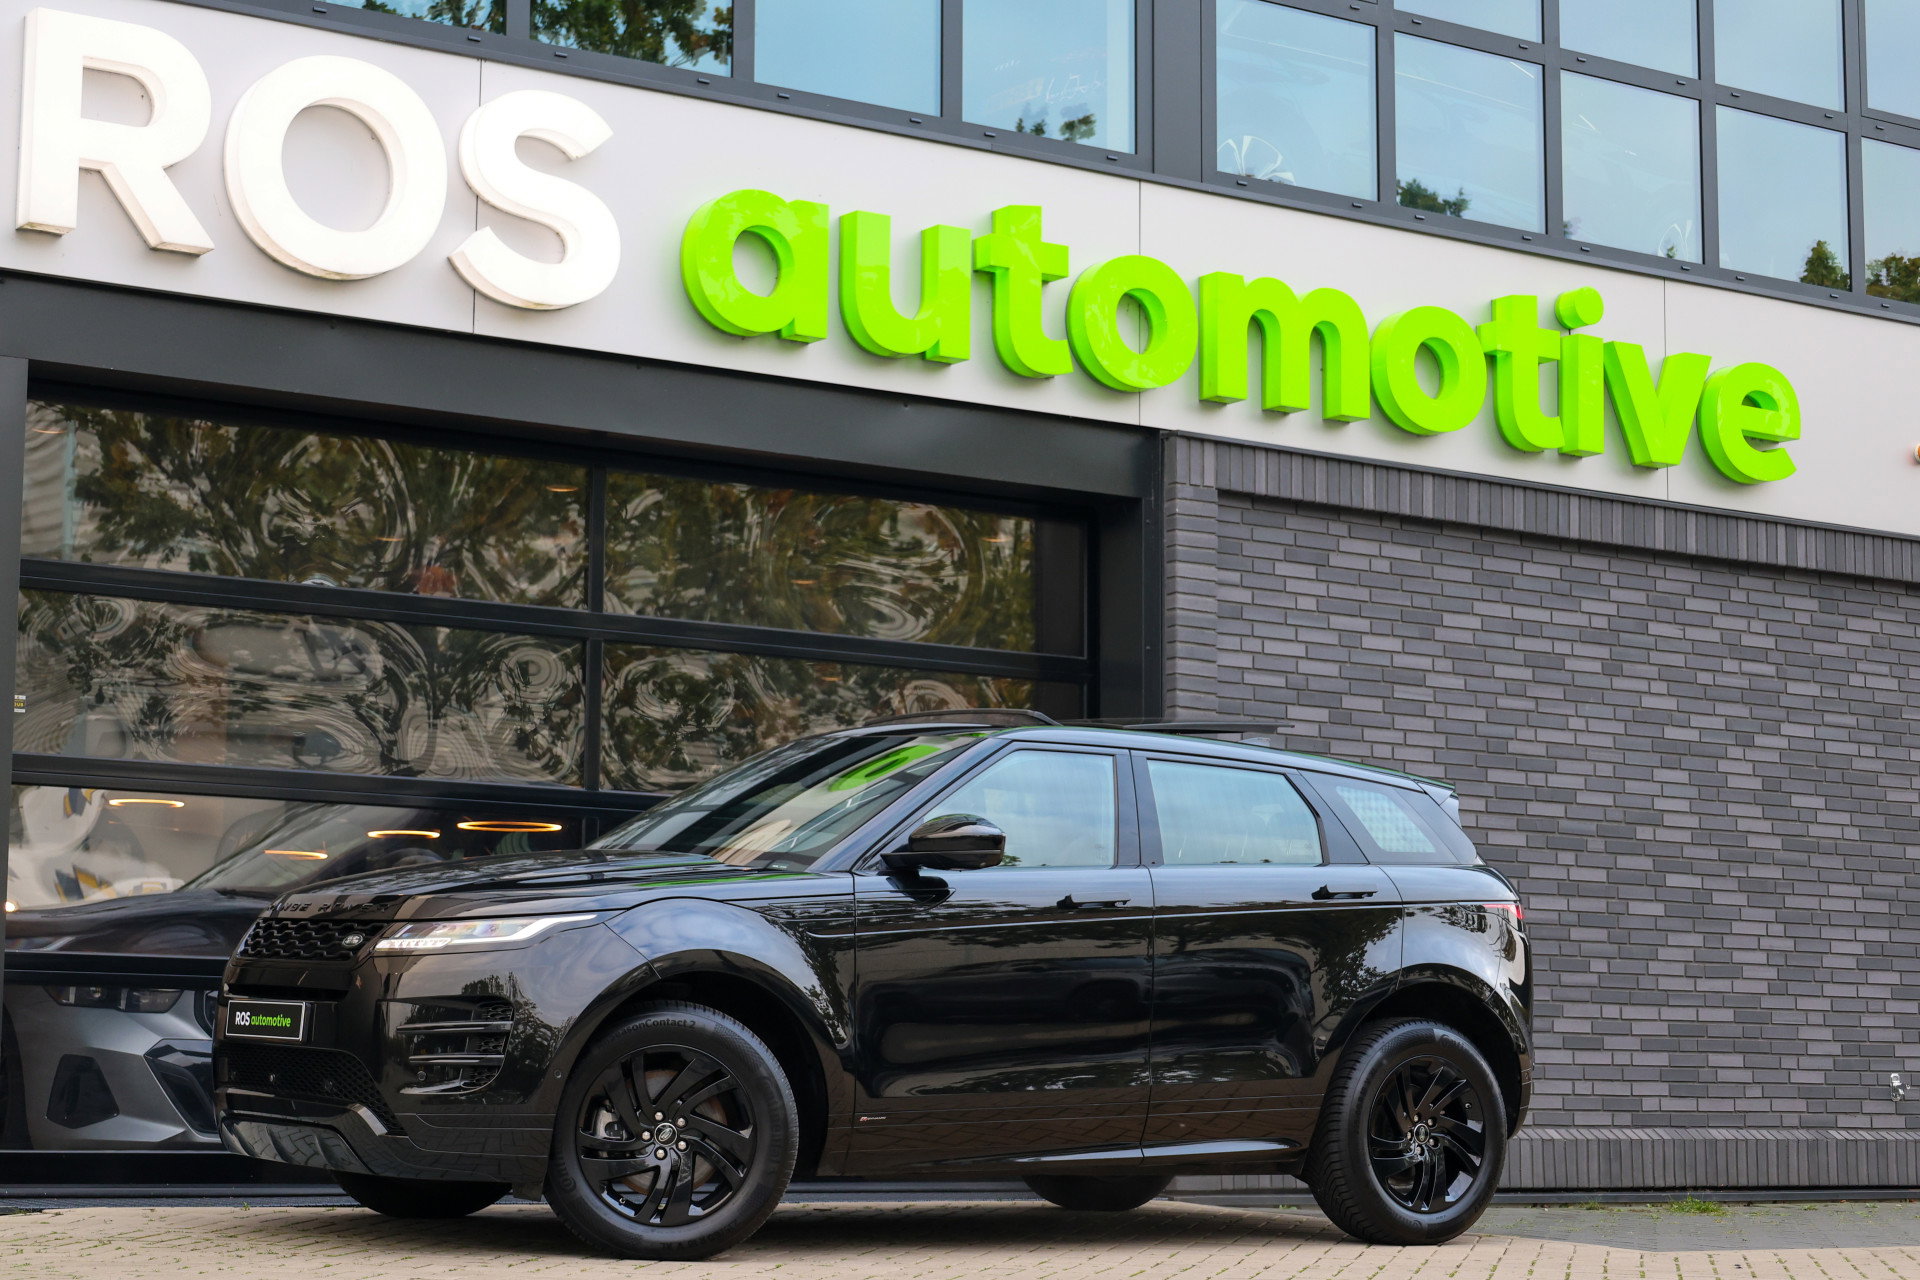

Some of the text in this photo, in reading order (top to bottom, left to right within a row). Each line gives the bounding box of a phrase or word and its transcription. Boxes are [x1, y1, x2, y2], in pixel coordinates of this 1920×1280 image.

[15, 6, 1801, 485] ROS automotive
[235, 1011, 291, 1027] ROS automotive
